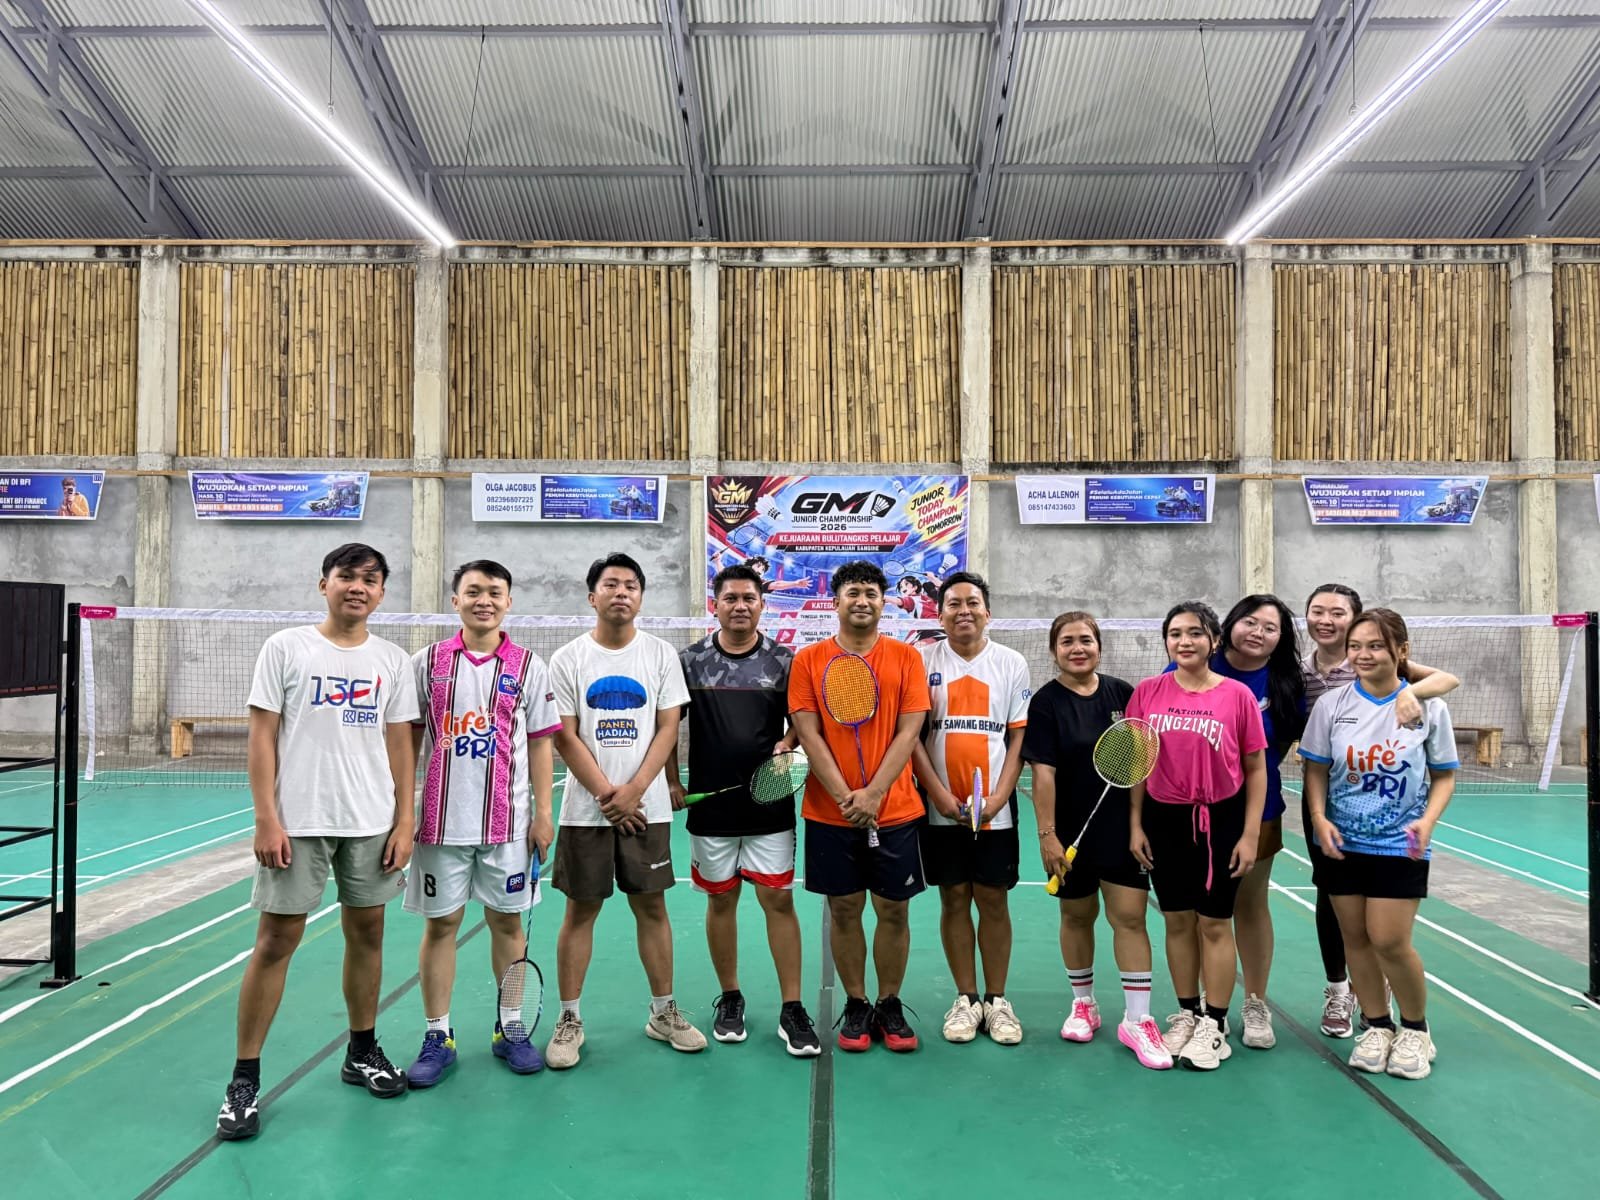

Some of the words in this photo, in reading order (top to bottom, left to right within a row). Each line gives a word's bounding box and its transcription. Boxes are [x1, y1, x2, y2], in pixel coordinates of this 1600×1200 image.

[11, 478, 18, 486] DI
[20, 478, 31, 486] BFI
[485, 483, 504, 491] OLGA
[505, 483, 536, 491] JACOBUS
[197, 484, 246, 492] WUJUDKAN
[247, 484, 277, 492] SETIAP
[278, 484, 309, 492] IMPIAN
[910, 486, 945, 511] JUNIOR
[1027, 490, 1046, 499] ACHA
[1047, 490, 1080, 499] LALENOH
[24, 497, 48, 505] FINANCE
[791, 490, 876, 514] GM
[916, 497, 945, 518] TODAY
[791, 515, 817, 523] JUNIOR
[819, 515, 873, 523] CHAMPIONSHIP
[917, 504, 958, 529] CHAMPION
[820, 523, 847, 531] 2026
[926, 512, 963, 535] TOMORROW
[780, 534, 821, 542] KEJUARAAN
[822, 534, 869, 542] BULUTANGKIS
[870, 534, 901, 542] PELAJAR
[1168, 706, 1214, 717] NATIONAL
[357, 711, 378, 724] BRI
[443, 710, 486, 736] life
[600, 721, 633, 729] PANEN
[944, 719, 977, 730] SAWANG
[597, 729, 636, 738] HADIAH
[1346, 744, 1395, 773] life
[424, 873, 437, 898] 8
[510, 876, 523, 886] BRI
